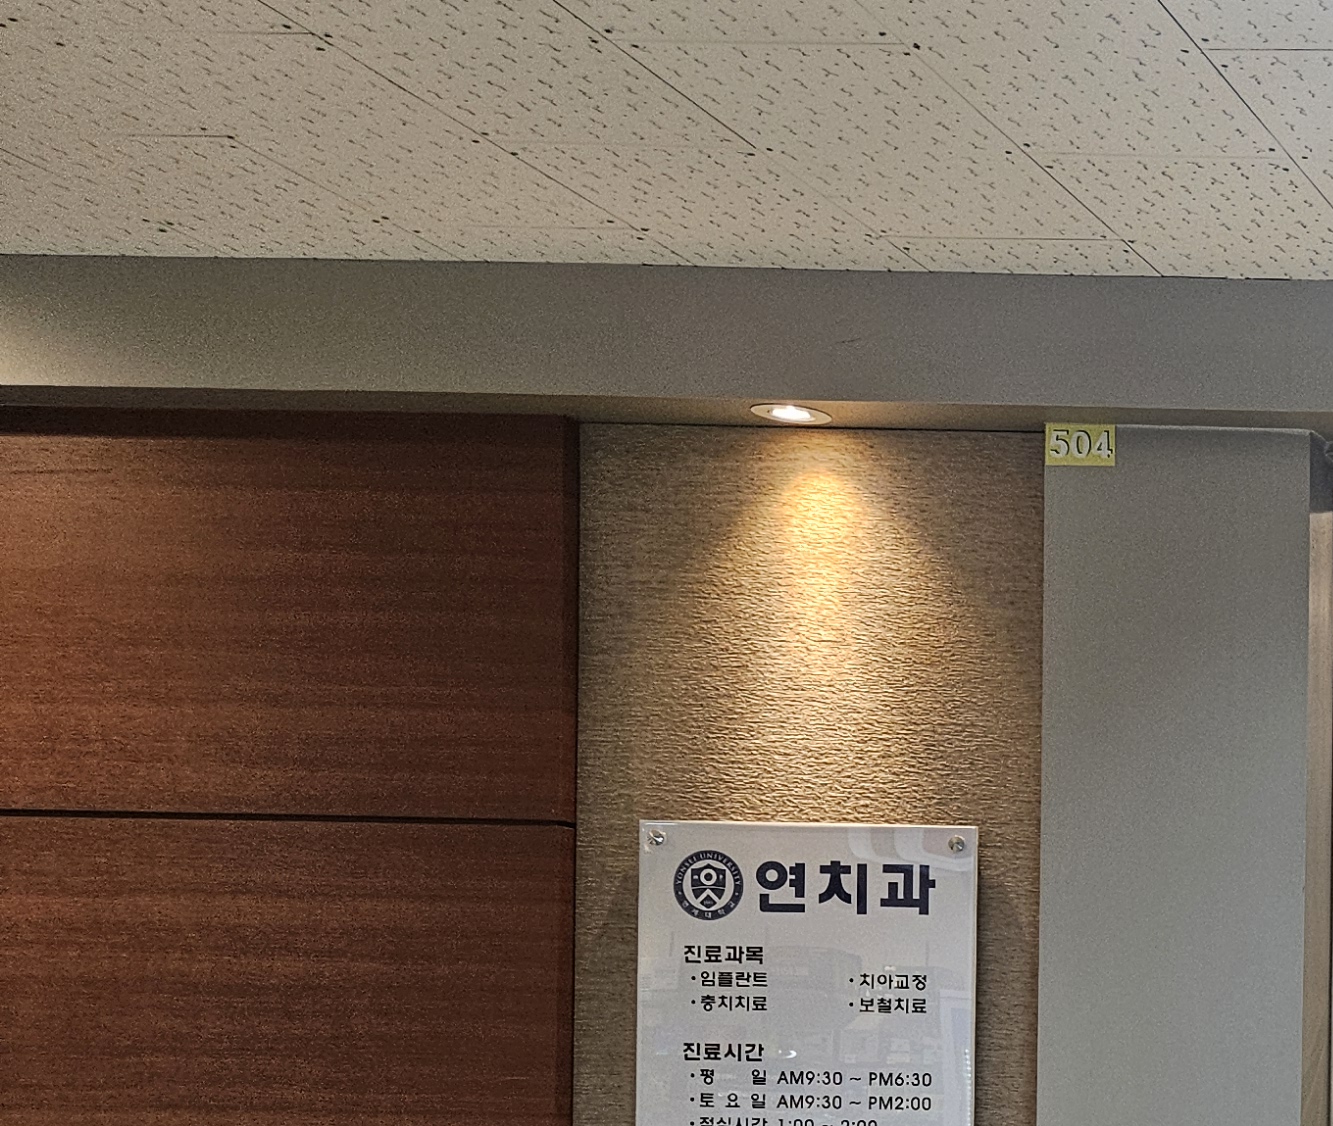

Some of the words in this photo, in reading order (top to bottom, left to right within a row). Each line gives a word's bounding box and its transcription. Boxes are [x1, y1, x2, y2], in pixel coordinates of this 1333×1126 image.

[1049, 429, 1114, 459] 504
[756, 860, 936, 915] 연치과
[683, 945, 764, 965] 진료과목
[700, 970, 768, 989] 임플란트
[859, 972, 927, 991] 치아교정
[700, 994, 768, 1012] 충치치료
[859, 997, 927, 1015] 보철치료
[682, 1042, 764, 1062] 진료시간
[777, 1071, 843, 1086] AM9:30
[869, 1071, 932, 1087] PM6:30
[777, 1094, 843, 1111] AM9:30
[868, 1096, 932, 1112] PM2:00
